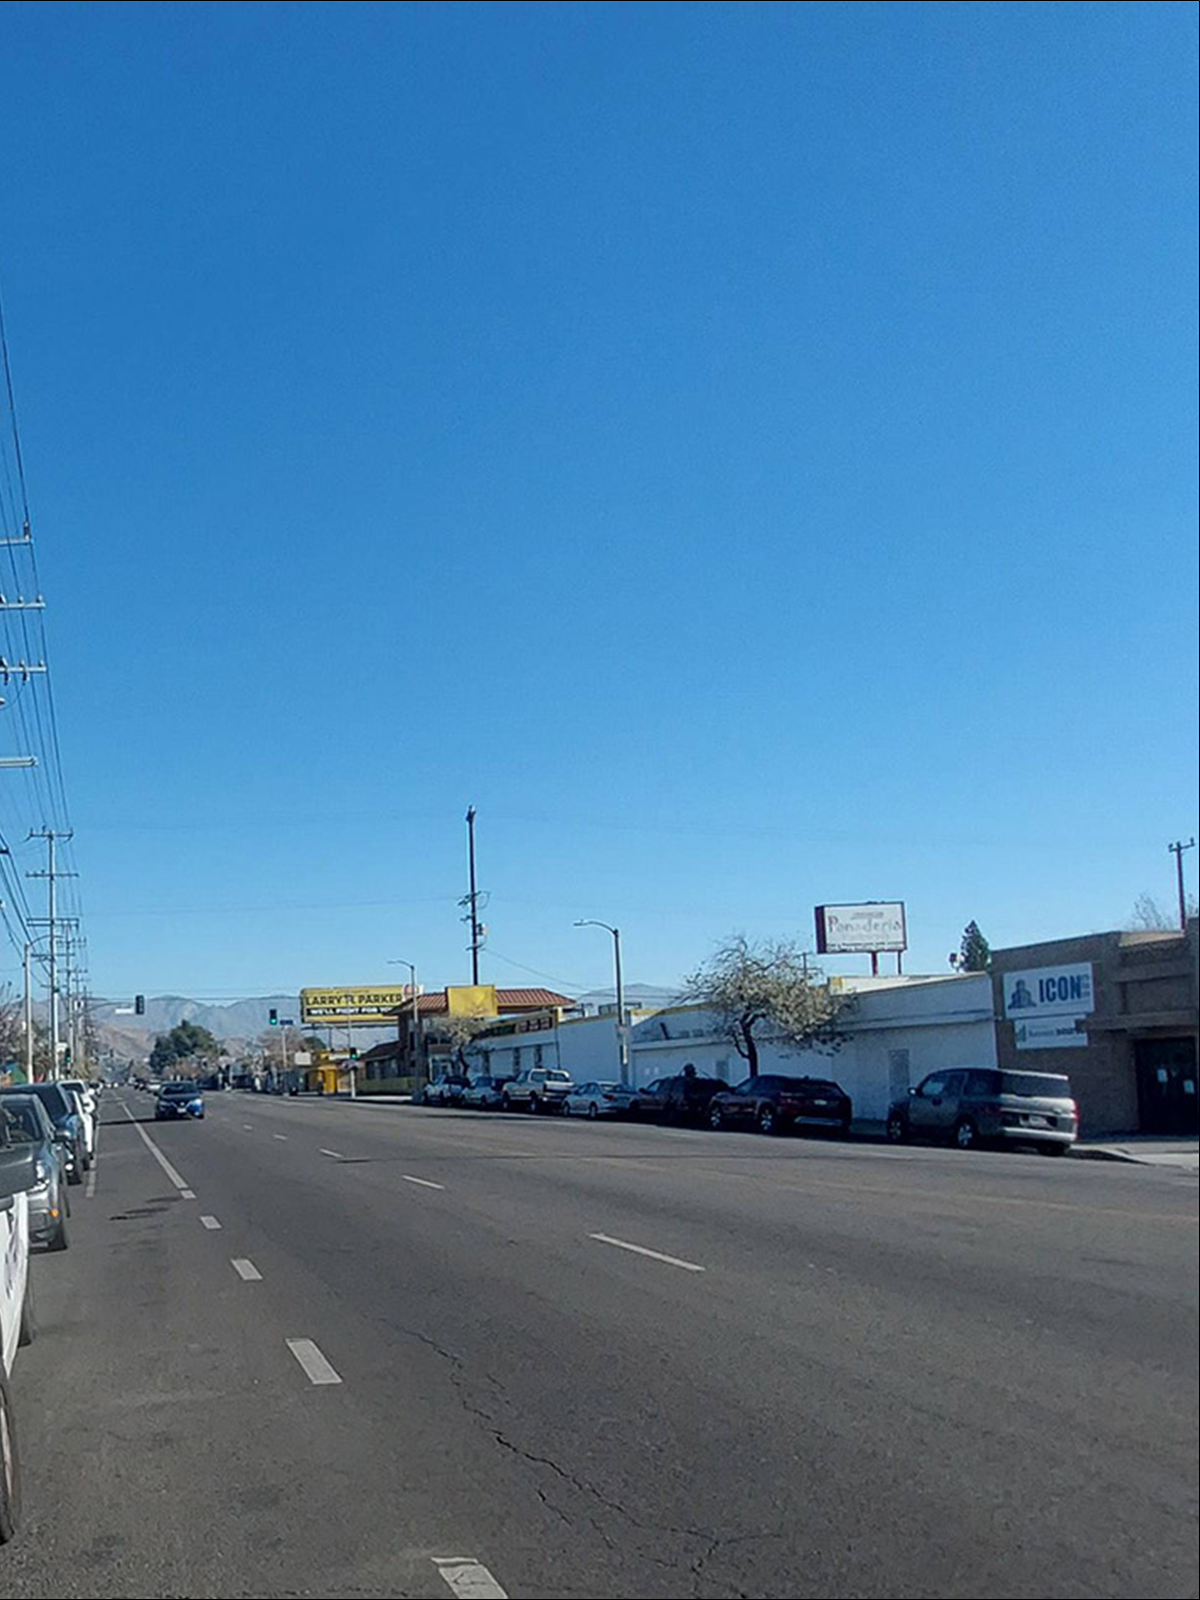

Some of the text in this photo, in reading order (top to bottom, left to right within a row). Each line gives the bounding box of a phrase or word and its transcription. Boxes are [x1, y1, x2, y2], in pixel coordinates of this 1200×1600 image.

[306, 995, 341, 1005] LARRY
[358, 993, 402, 1004] PARKER
[1039, 975, 1081, 1003] ICON
